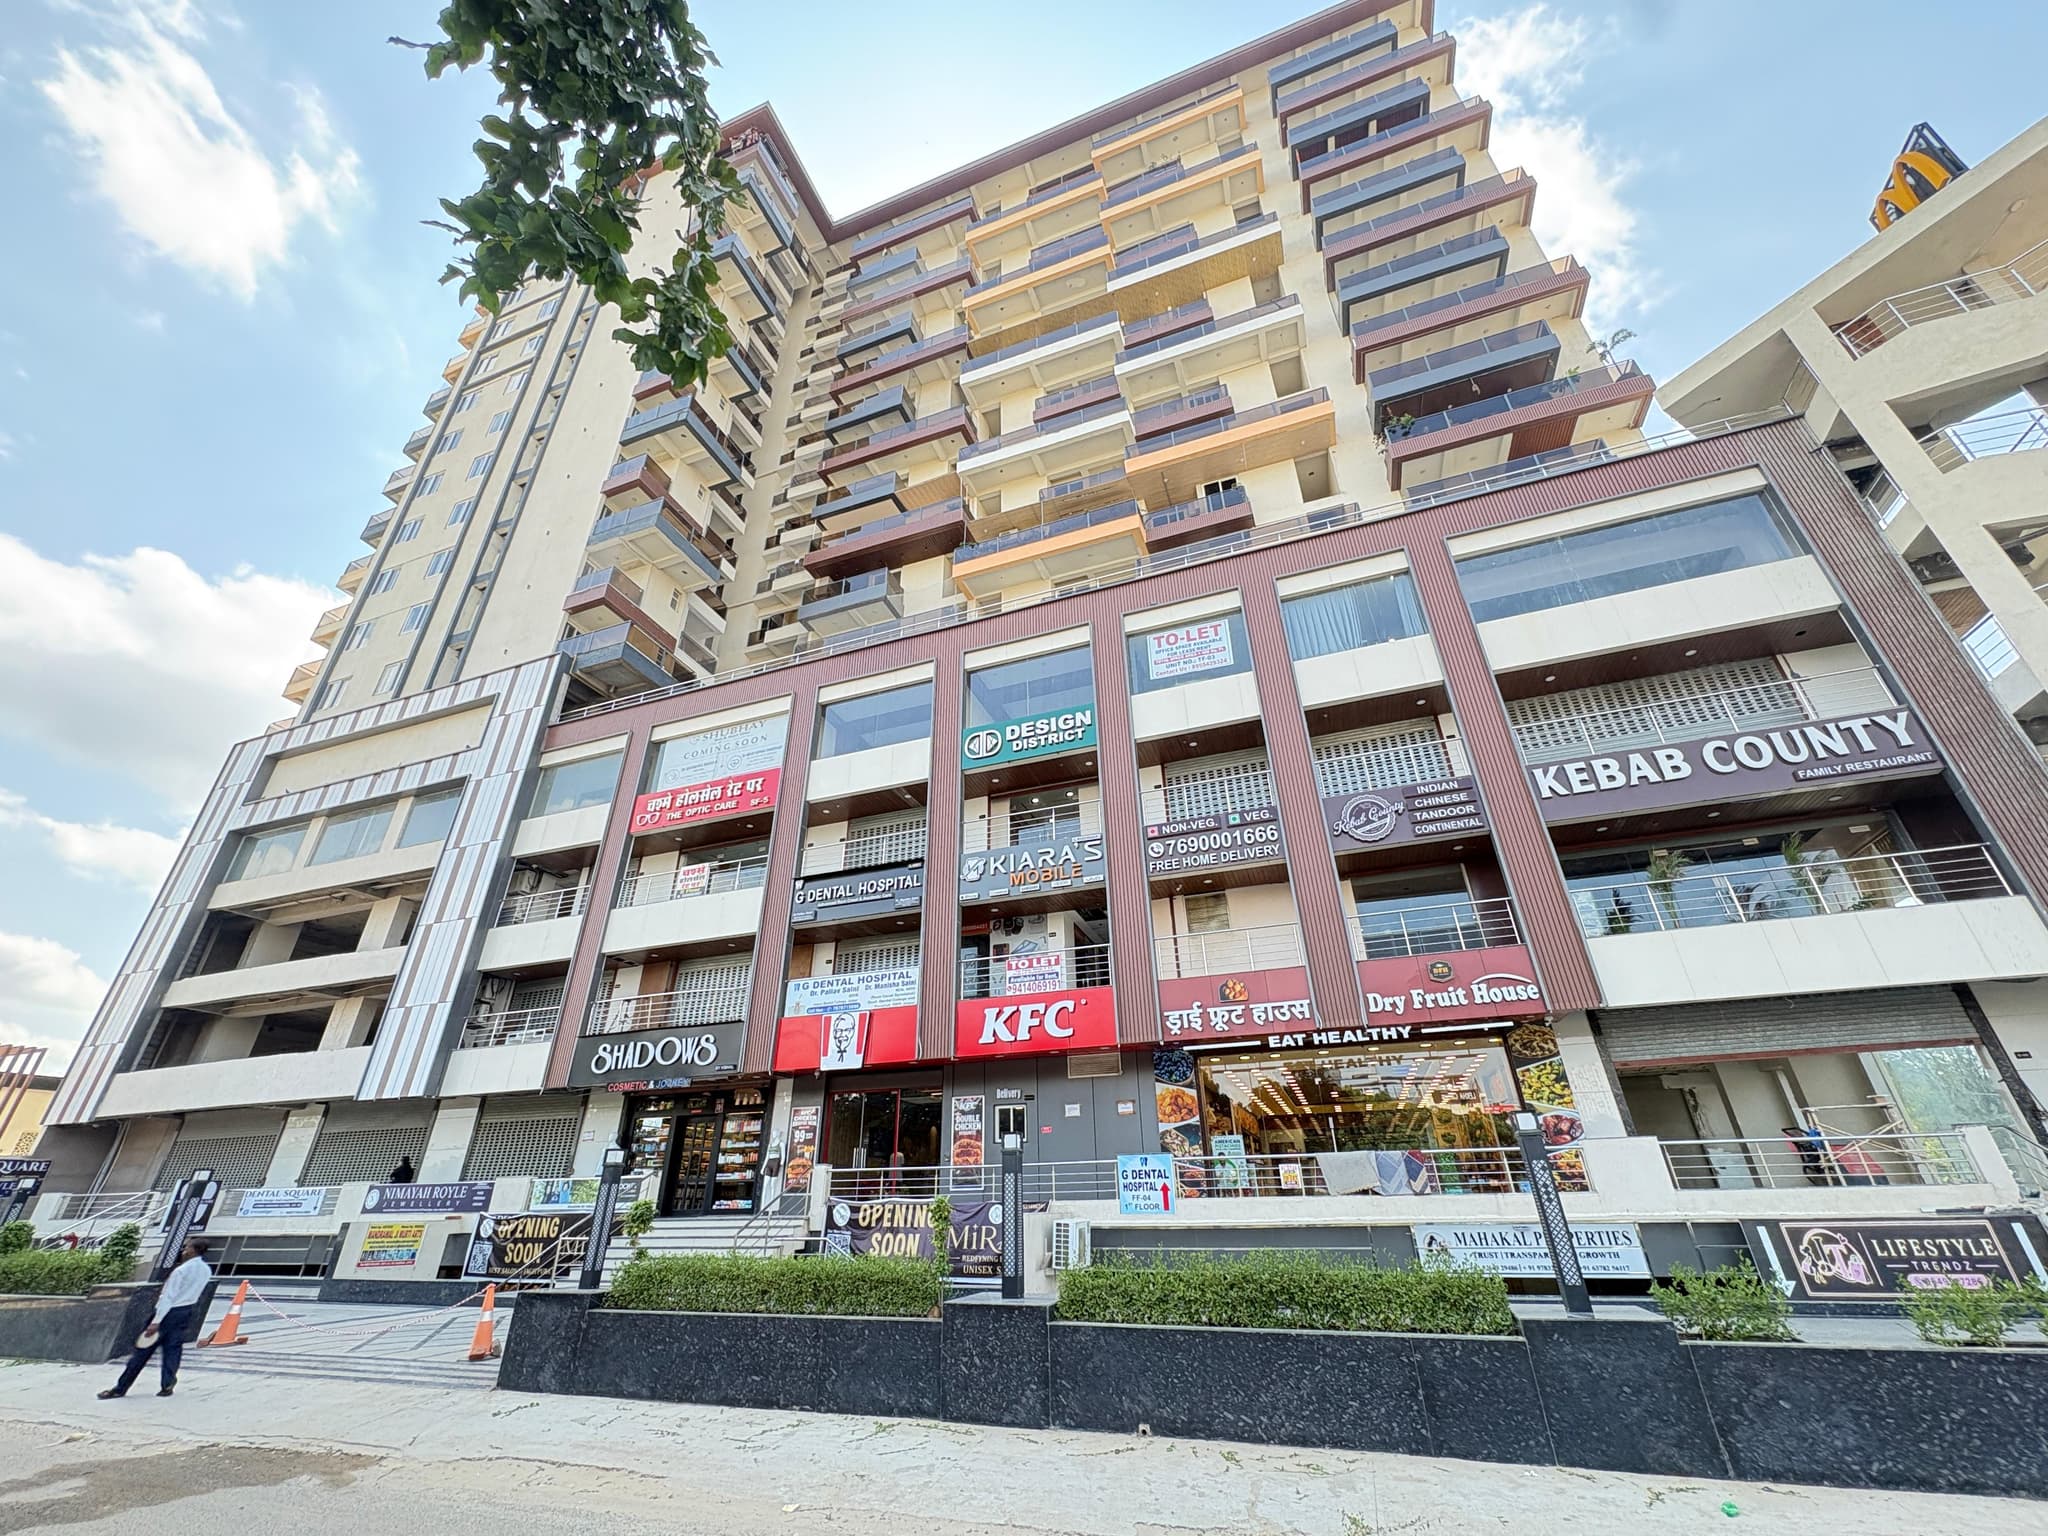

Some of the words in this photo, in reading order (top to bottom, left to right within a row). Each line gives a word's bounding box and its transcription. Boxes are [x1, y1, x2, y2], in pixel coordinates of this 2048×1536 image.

[1153, 624, 1222, 648] TO-LET
[1006, 710, 1092, 741] DESIGN
[683, 744, 731, 760] COMING
[735, 734, 768, 748] SOON
[1012, 728, 1086, 752] DISTRICT
[1532, 748, 1693, 799] KEBAB
[1702, 711, 1916, 774] COUNTY
[1798, 762, 1844, 779] FAMILY
[1846, 750, 1933, 772] RESTAURANT
[675, 785, 723, 808] होलसेल
[727, 779, 743, 798] रेट
[746, 778, 764, 793] पर
[1416, 781, 1459, 794] INDIAN
[666, 810, 682, 820] THE
[686, 804, 710, 818] OPTIC
[714, 800, 738, 812] CARE
[1414, 792, 1470, 808] CHINESE
[1244, 810, 1273, 822] VEG.
[1368, 801, 1405, 822] County
[1414, 805, 1476, 821] TANDOOR
[1162, 818, 1218, 834] NON-VEG.
[1414, 816, 1484, 834] CONTINENTAL
[1165, 825, 1279, 856] 7690001666
[990, 840, 1104, 876] KIARA'S
[1149, 858, 1180, 873] FREE
[1182, 852, 1218, 868] HOME
[1220, 844, 1280, 860] DELIVERY
[1009, 862, 1084, 886] MOBILE
[796, 891, 804, 904] G
[808, 884, 854, 902] DENTAL
[858, 874, 921, 895] HOSPITAL
[1009, 958, 1030, 970] TO
[1032, 956, 1058, 968] LET
[802, 982, 810, 990] G
[812, 977, 854, 990] DENTAL
[857, 970, 912, 985] HOSPITAL
[1012, 980, 1062, 994] 9414069191
[1366, 992, 1406, 1016] Dry
[1410, 986, 1466, 1010] Fruit
[1471, 983, 1540, 1006] House
[978, 1000, 1076, 1044] KFC
[1164, 1002, 1203, 1036] ड्राई
[1208, 1004, 1246, 1034] फ्रूट
[1250, 998, 1311, 1027] हाउस
[1268, 1033, 1307, 1048] EAT
[1313, 1026, 1413, 1045] HEALTHY
[590, 1034, 718, 1074] SHADOWS
[608, 1080, 648, 1092] COSMETIC
[648, 1080, 654, 1089] &
[996, 1088, 1022, 1100] Delivery
[960, 1101, 978, 1110] KFC
[955, 1114, 980, 1122] DOUBLE
[955, 1122, 982, 1131] CHICKEN
[794, 1130, 806, 1142] 99
[1122, 1170, 1128, 1180] G
[1132, 1168, 1170, 1180] DENTAL
[245, 1190, 280, 1198] DENTAL
[284, 1188, 322, 1198] SQUARE
[432, 1186, 469, 1199] ROYLE
[1122, 1181, 1158, 1192] HOSPITAL
[382, 1200, 462, 1208] JEWELLERY
[498, 1216, 561, 1239] OPENING
[870, 1232, 920, 1257] SOON
[1454, 1230, 1532, 1247] MAHAKAL
[1534, 1230, 1633, 1247] PERTIES
[1870, 1238, 2000, 1258] LIFESTYLE
[504, 1242, 544, 1265] SOON
[1472, 1252, 1500, 1260] TRUST
[1505, 1252, 1552, 1260] TRANSPAR
[1578, 1252, 1620, 1260] GROWTH
[962, 1264, 992, 1275] UNISEX
[1910, 1260, 1974, 1272] TRENDZ
